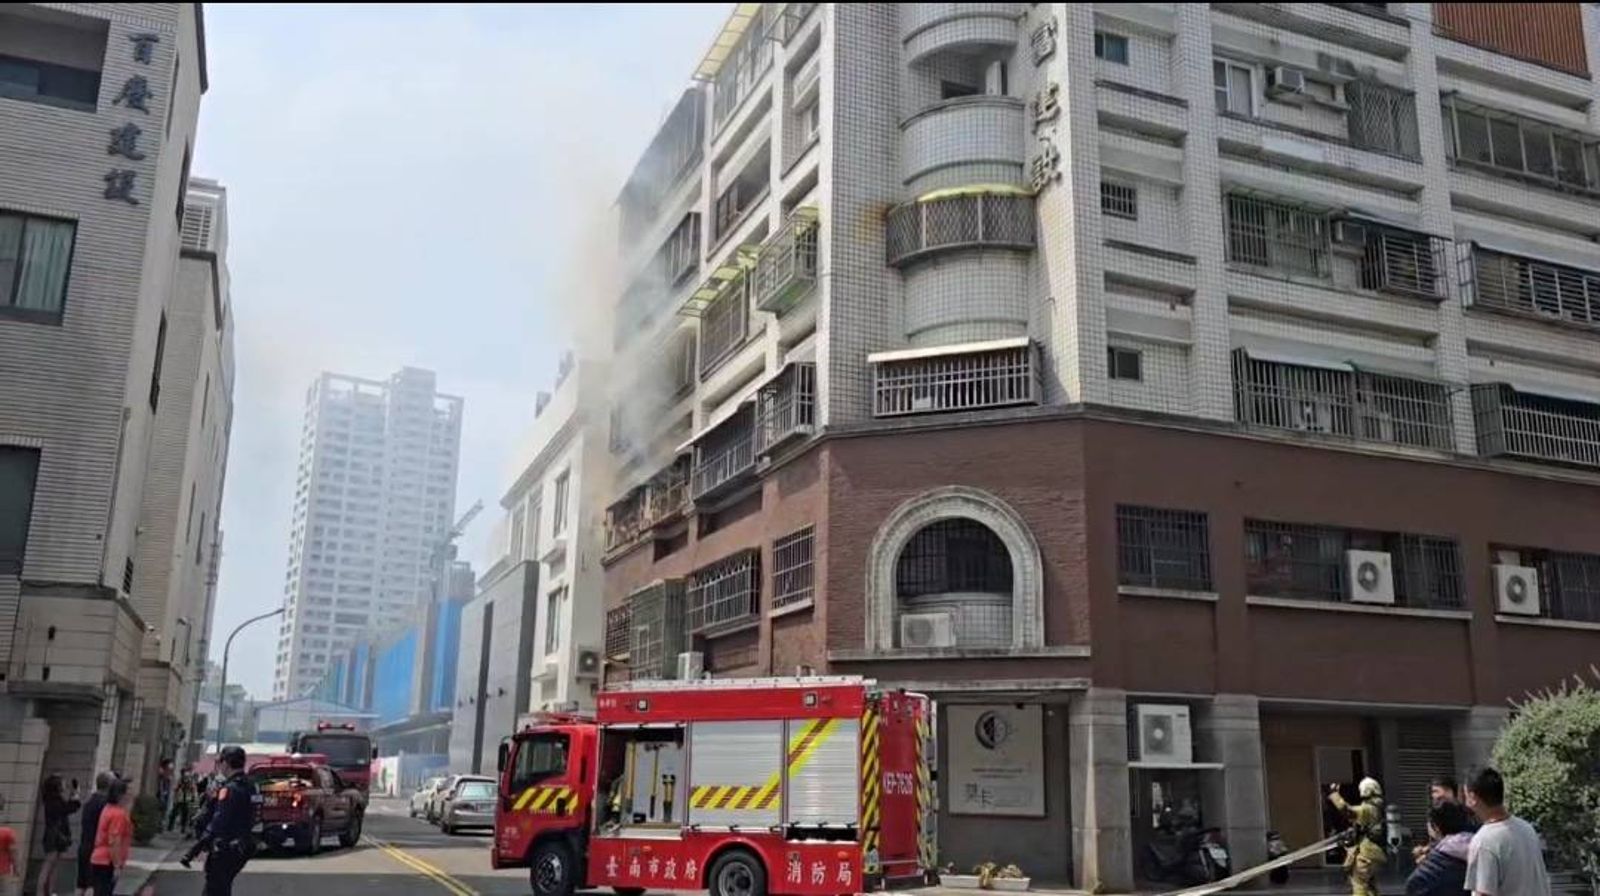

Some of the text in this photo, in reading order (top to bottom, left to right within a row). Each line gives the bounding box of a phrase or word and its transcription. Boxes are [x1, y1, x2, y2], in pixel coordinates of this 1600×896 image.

[606, 855, 852, 886] 臺南市政府 消防局
